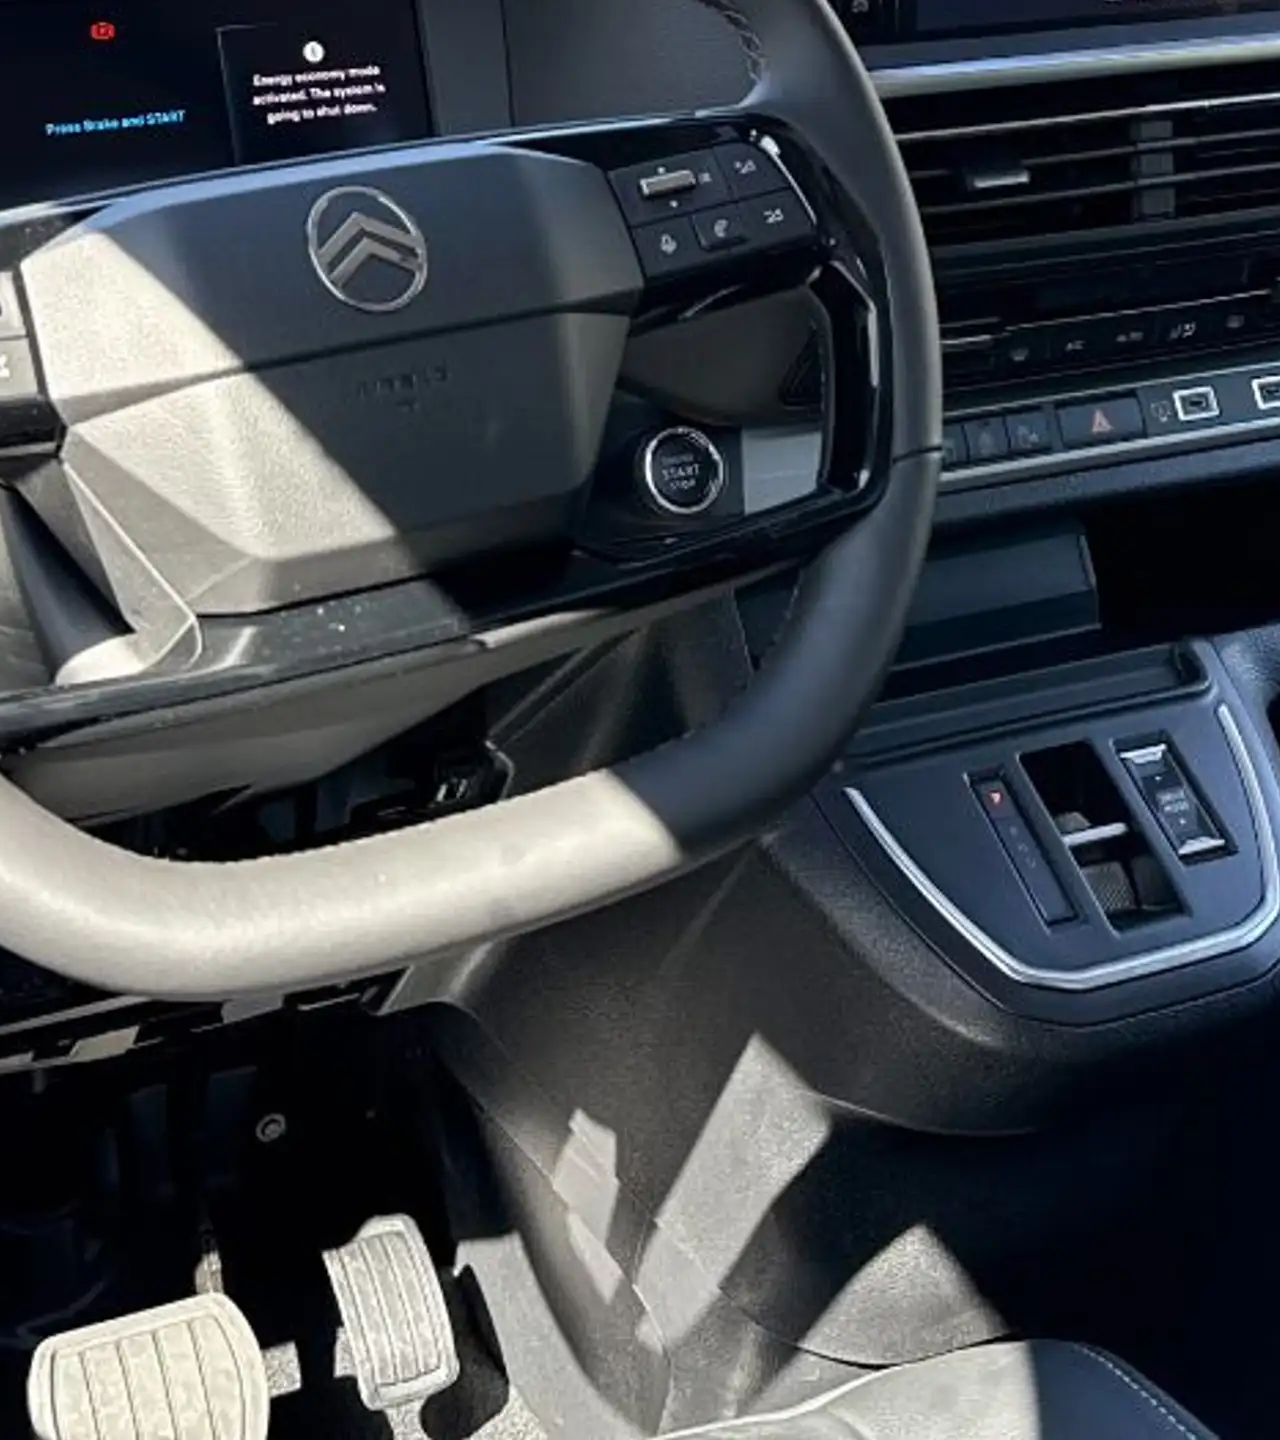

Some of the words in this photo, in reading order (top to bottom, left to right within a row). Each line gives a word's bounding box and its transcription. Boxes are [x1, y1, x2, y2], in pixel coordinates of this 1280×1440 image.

[252, 74, 293, 87] Energy
[294, 69, 346, 83] economy
[347, 64, 381, 78] mode
[252, 88, 308, 106] activated.
[308, 86, 332, 100] The
[332, 83, 374, 100] system
[373, 81, 387, 93] is
[44, 122, 82, 137] Press
[82, 117, 120, 132] Brake
[120, 113, 145, 128] and
[145, 109, 186, 126] START
[266, 108, 300, 125] going
[301, 108, 315, 120] to
[316, 104, 341, 117] shut
